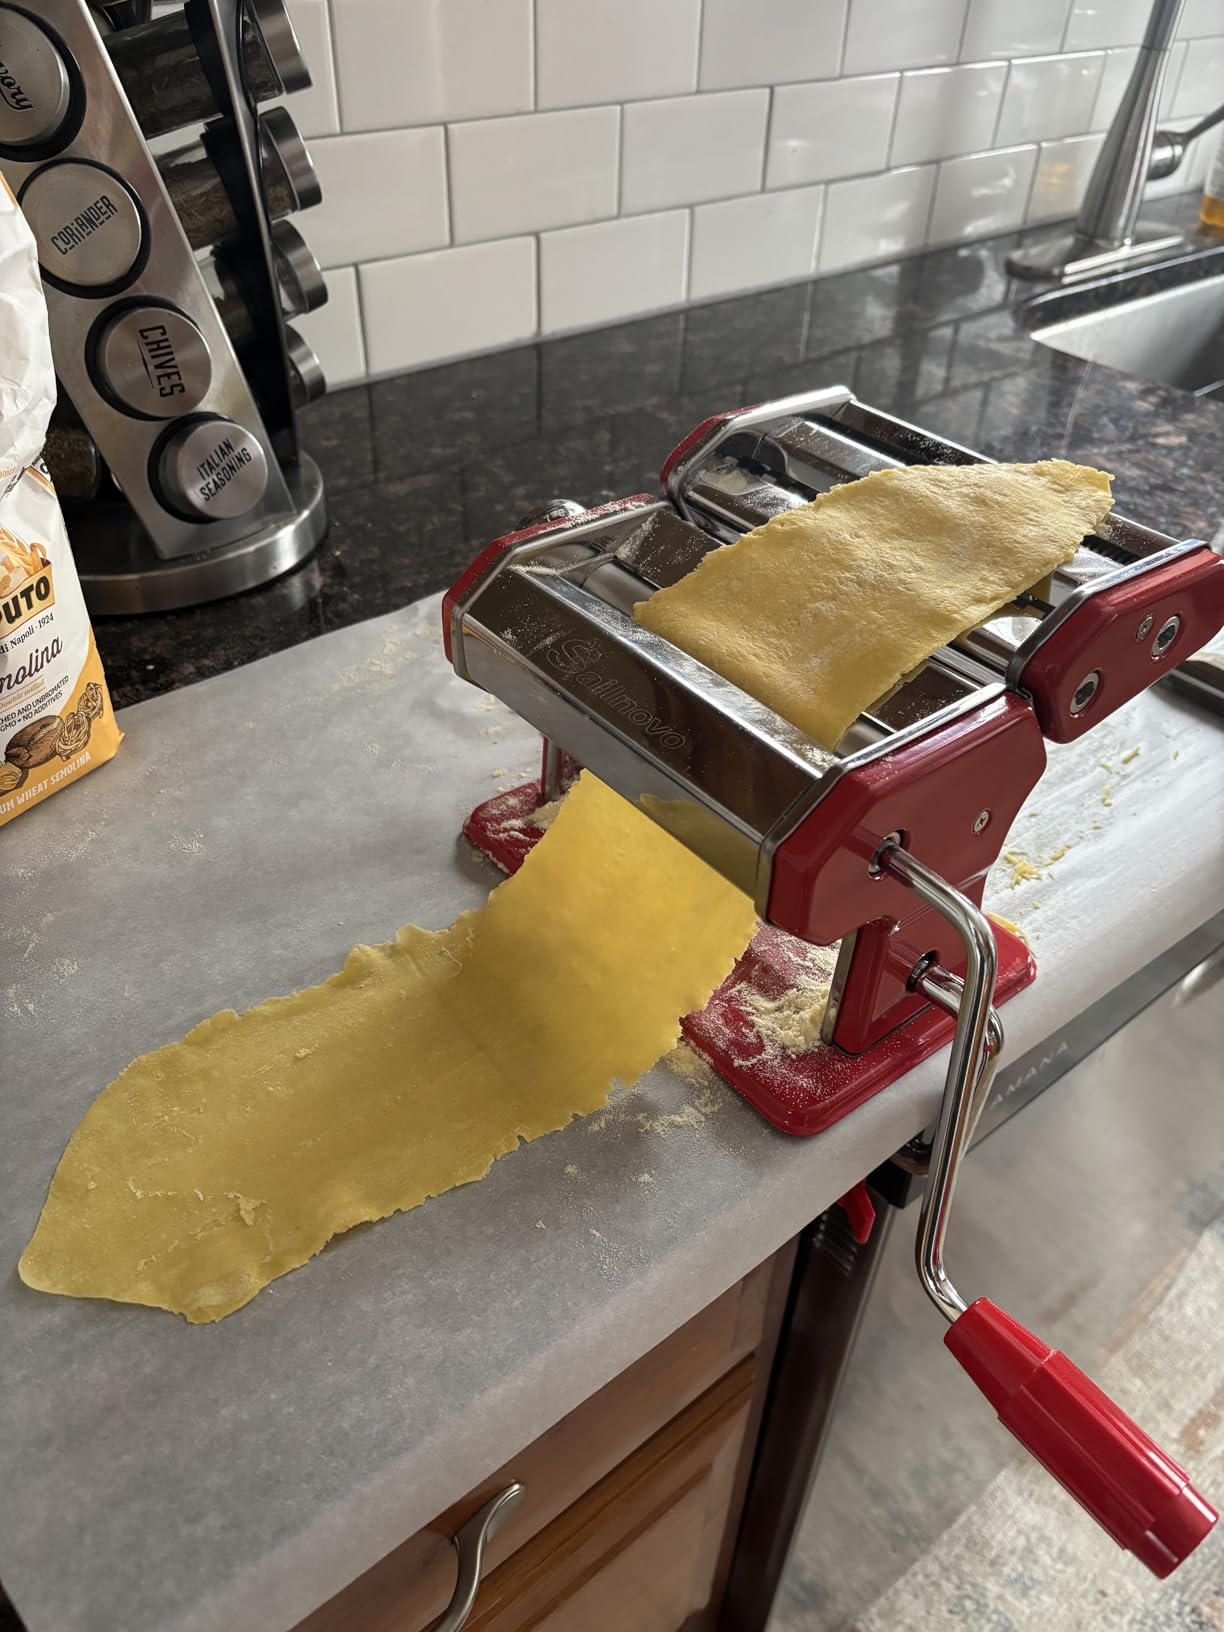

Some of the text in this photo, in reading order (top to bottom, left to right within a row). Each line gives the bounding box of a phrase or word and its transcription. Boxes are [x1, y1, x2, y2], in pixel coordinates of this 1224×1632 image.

[138, 324, 186, 398] CHIVES
[197, 438, 234, 481] ITALIAN
[199, 447, 252, 501] SEASONING
[10, 625, 35, 649] Napoli
[17, 703, 32, 716] AND
[32, 675, 69, 707] UNBROMATED
[22, 712, 33, 722] NO
[34, 690, 63, 715] ADDITIVES
[16, 779, 49, 805] WHEAT
[50, 751, 91, 785] SEMOLINA
